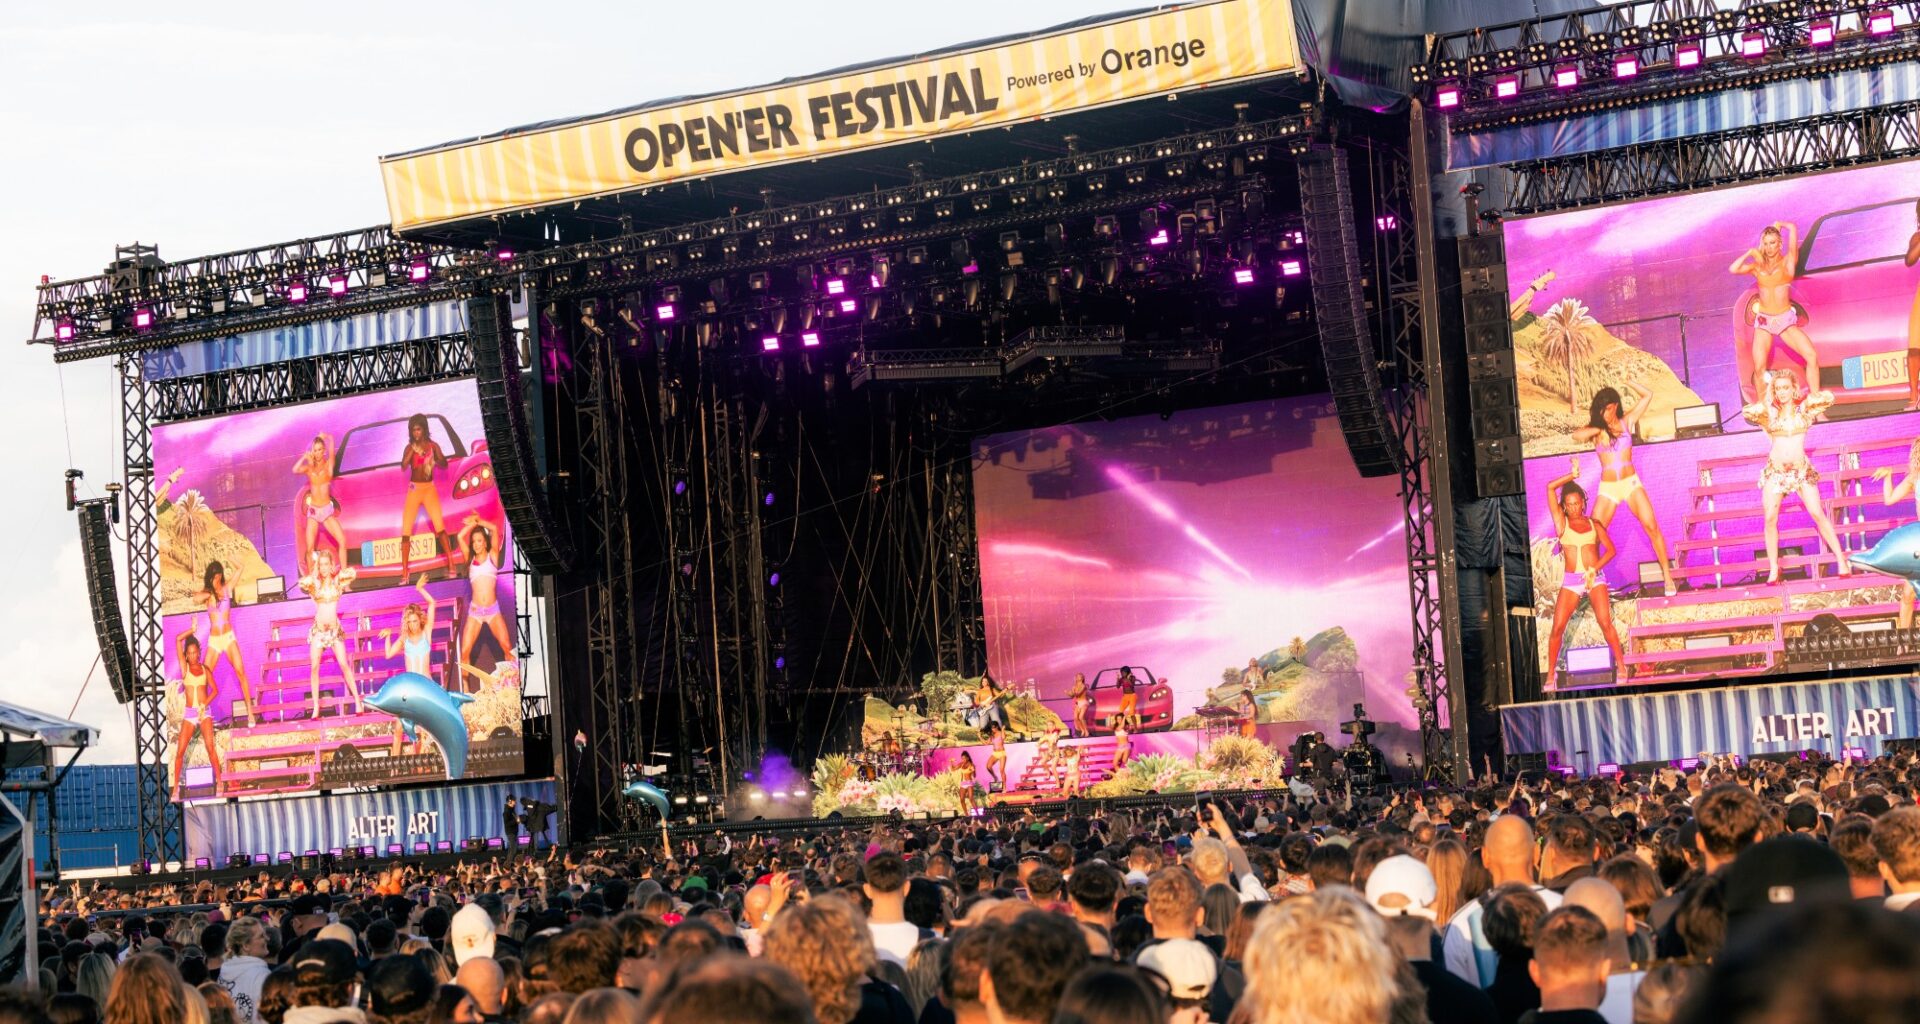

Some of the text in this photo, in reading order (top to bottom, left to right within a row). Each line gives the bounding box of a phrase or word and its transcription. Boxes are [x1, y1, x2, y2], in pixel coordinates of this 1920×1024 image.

[625, 38, 1206, 172] OPEN'ER FESTIVAL Powered by Orange
[1863, 358, 1899, 382] PUSS
[374, 543, 396, 561] PUSS
[1752, 707, 1895, 743] ALTER ART
[348, 811, 438, 839] ALTER ART
